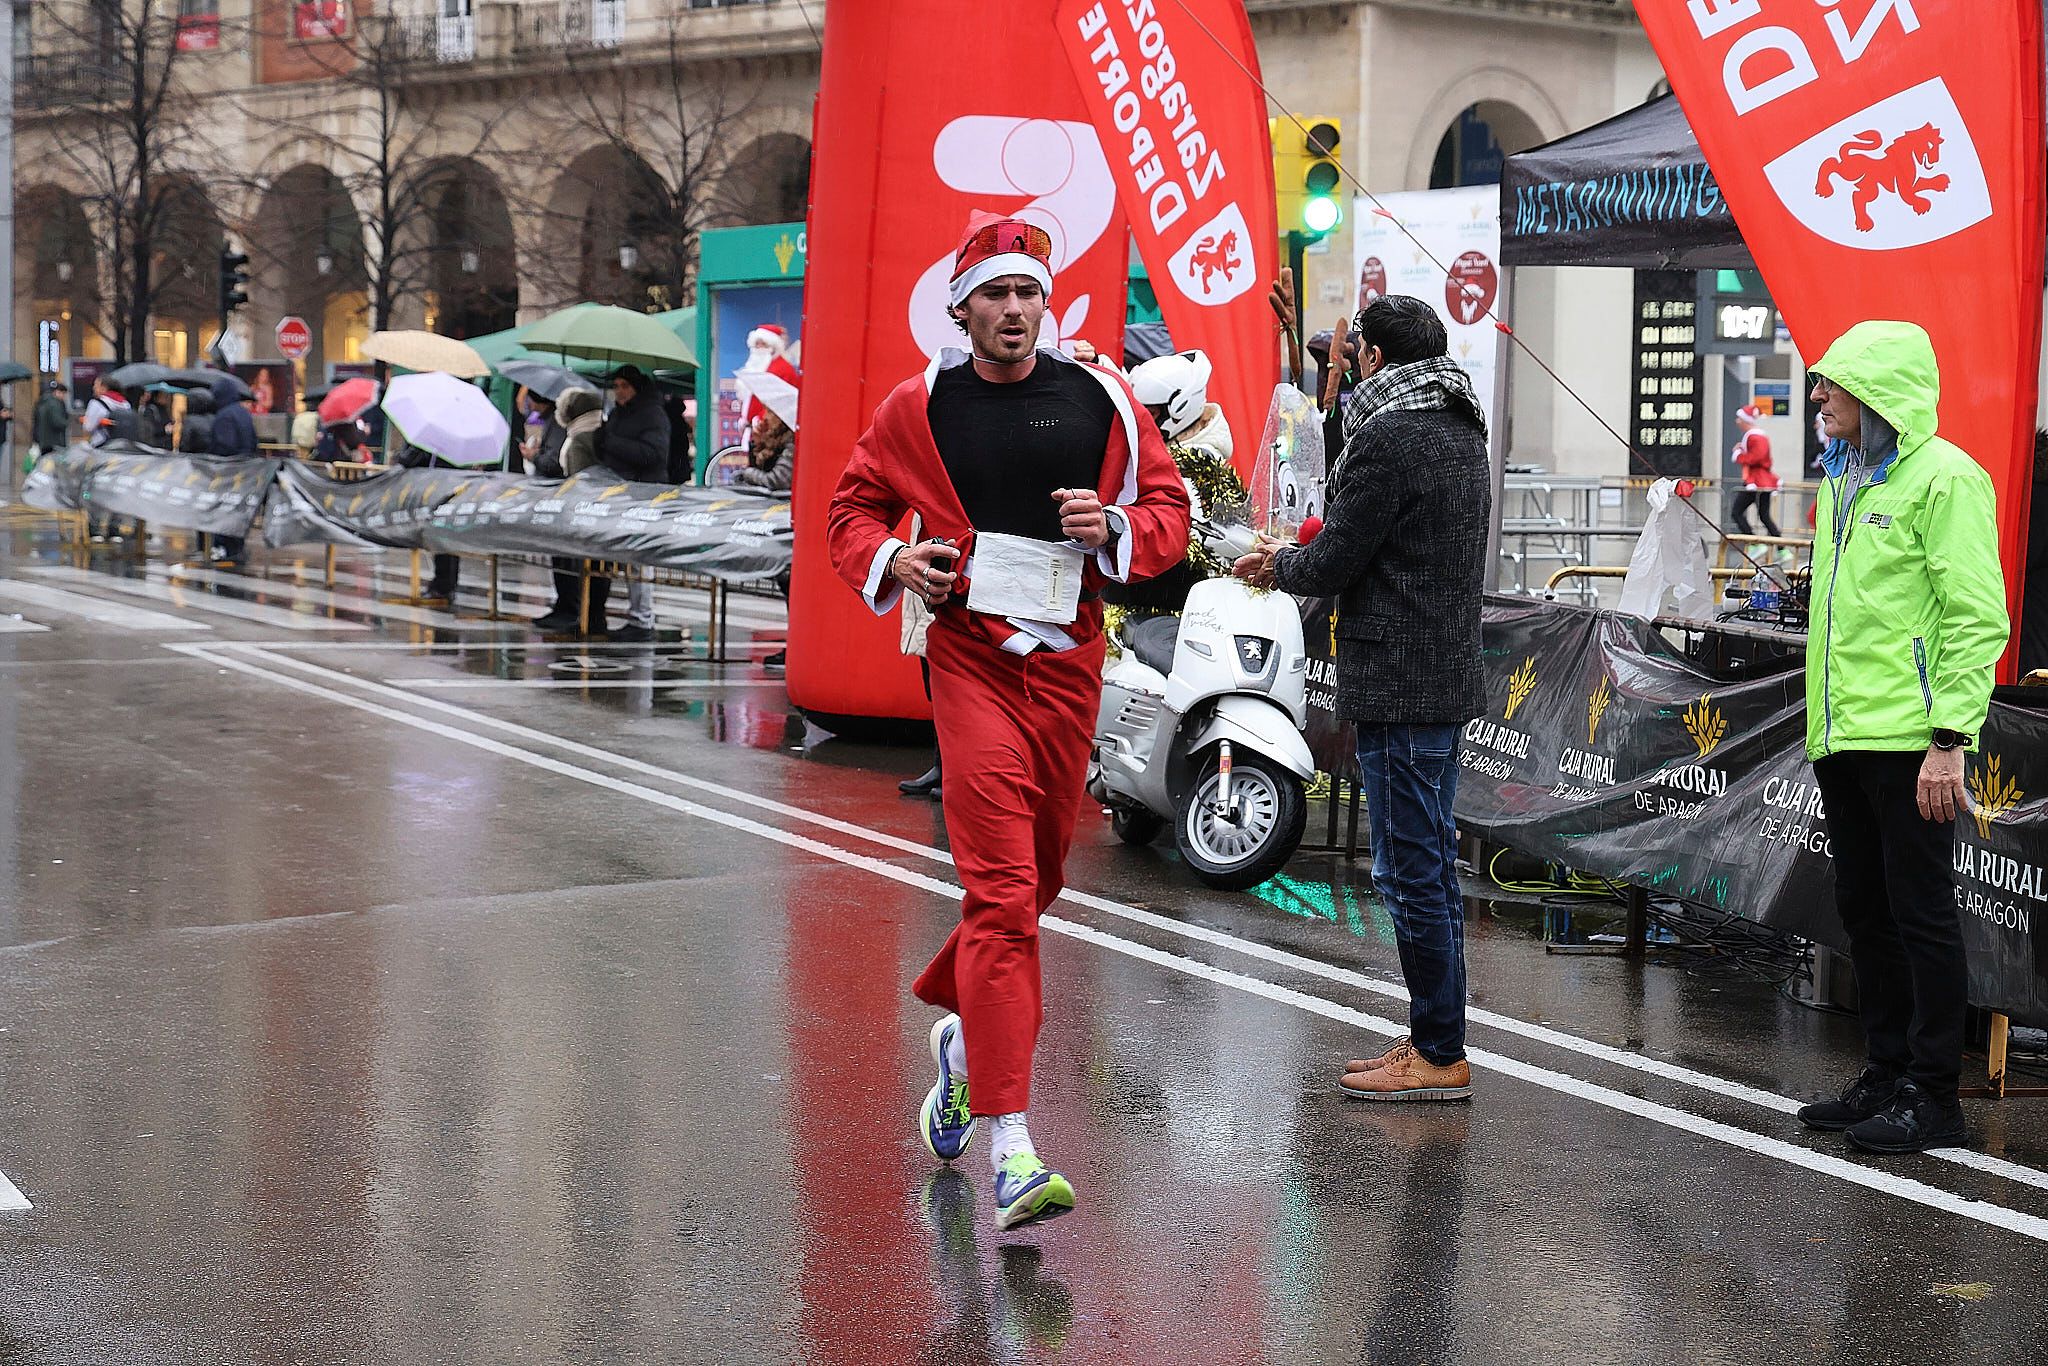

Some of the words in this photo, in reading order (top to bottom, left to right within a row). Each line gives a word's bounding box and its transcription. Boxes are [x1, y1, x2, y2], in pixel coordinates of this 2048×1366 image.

[279, 332, 307, 345] STOP
[1304, 657, 1324, 683] AJA
[1465, 717, 1497, 749] CAJA
[1492, 726, 1532, 760] RURAL
[1460, 749, 1474, 767] DE
[1471, 755, 1515, 781] ARAGÓN
[1558, 747, 1585, 777] CAJA
[1581, 753, 1617, 786] RURAL
[1668, 764, 1728, 798] RURAL
[1634, 790, 1655, 813] DE
[1763, 776, 1807, 812] CAJA
[1759, 816, 1781, 840] DE
[1979, 849, 2048, 902] RURAL
[1954, 884, 1964, 909] E
[1966, 890, 2029, 934] ARAGÓN
